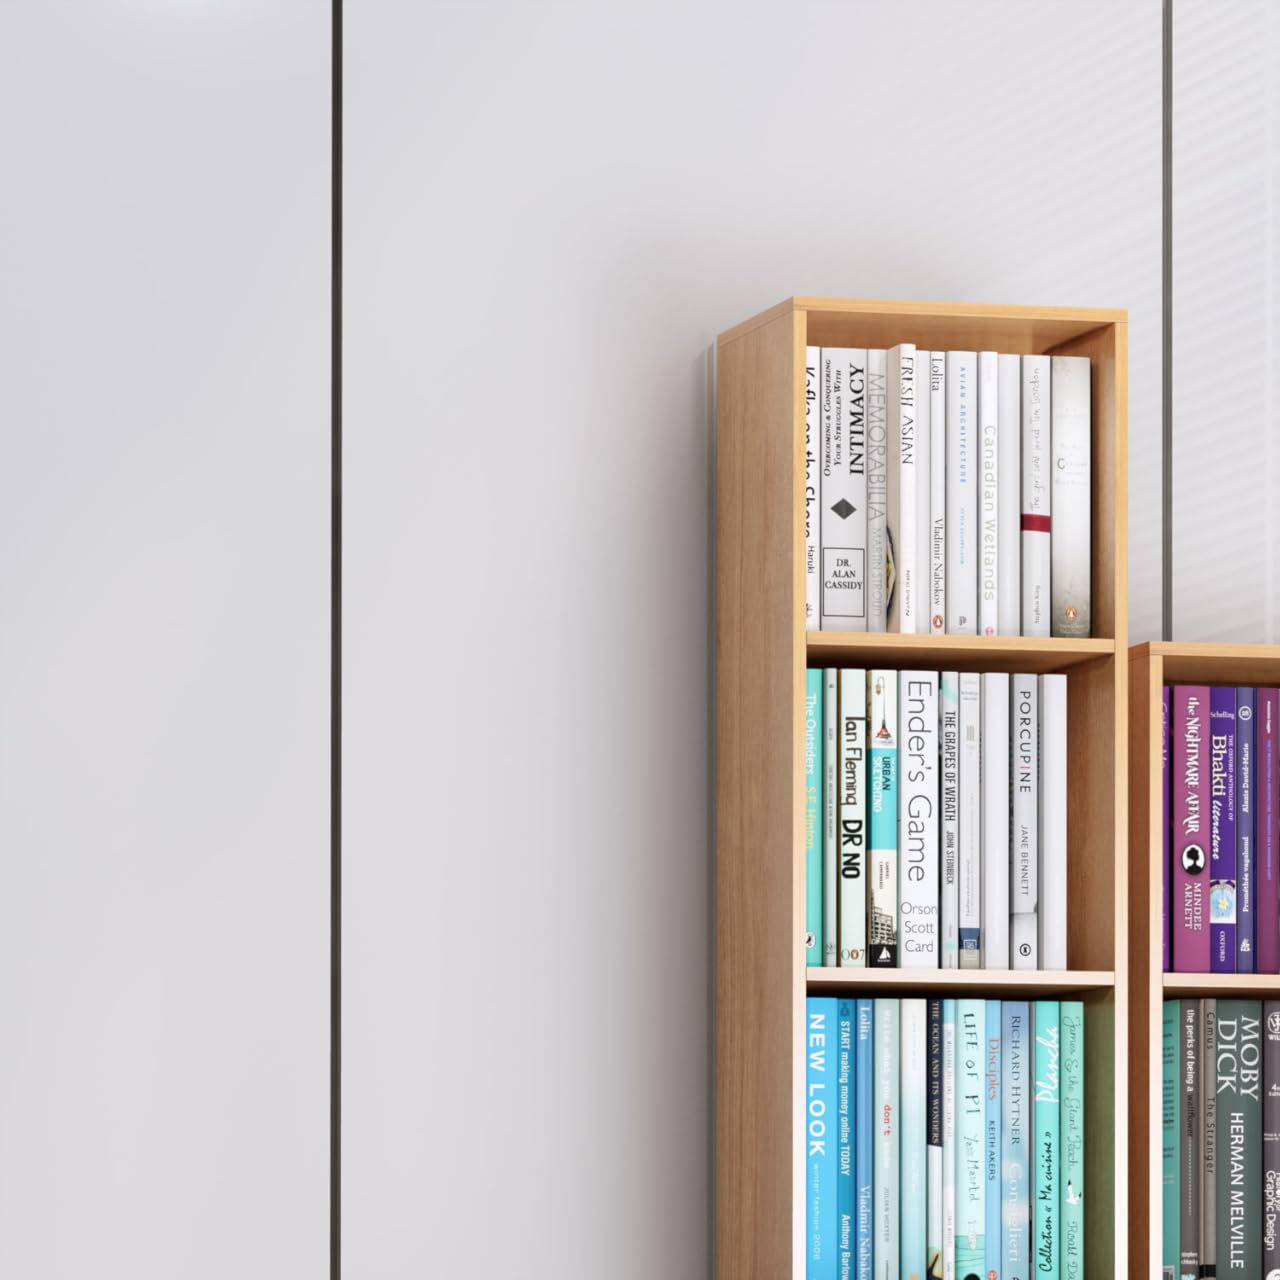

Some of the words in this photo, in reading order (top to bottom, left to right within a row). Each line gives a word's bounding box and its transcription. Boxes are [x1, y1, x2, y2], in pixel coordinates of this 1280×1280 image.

[901, 357, 913, 405] FRESH
[932, 358, 943, 391] Lolita
[850, 363, 864, 475] INTIMACY
[869, 373, 885, 521] MEMORABILIA
[901, 416, 913, 464] ASIAN
[984, 425, 996, 512] Canadian
[933, 518, 943, 559] Vladimir
[807, 546, 815, 573] Haruki
[836, 559, 850, 568] DR.
[984, 519, 996, 600] Wetlands
[825, 581, 862, 589] CASSIDY
[933, 564, 943, 605] Nabokov
[845, 716, 866, 742] Ian
[908, 680, 931, 782] Ender's
[945, 712, 955, 728] THE
[945, 732, 956, 768] GRAPES
[1020, 691, 1030, 792] PORCUPINE
[841, 747, 862, 805] Fleming
[882, 757, 890, 790] URBAN
[945, 772, 955, 784] OF
[1212, 735, 1227, 796] Bhakti
[944, 787, 955, 820] WRATH
[842, 819, 862, 846] DR
[908, 795, 931, 882] Game
[946, 831, 954, 847] JOHN
[1020, 825, 1029, 848] JANE
[1212, 800, 1222, 860] literature
[842, 854, 860, 878] NO
[946, 850, 954, 884] STEINBECK
[1020, 852, 1028, 896] BENNETT
[900, 902, 938, 914] Orson
[1184, 883, 1192, 929] ARNETT
[1194, 883, 1202, 930] MINDEE
[904, 921, 934, 933] Scott
[904, 940, 933, 952] Card
[810, 1013, 825, 1072] NEW
[841, 1021, 850, 1049] START
[860, 1007, 870, 1040] Lolita
[839, 1052, 850, 1082] making
[1011, 1016, 1020, 1080] RICHARD
[1217, 1019, 1236, 1094] DICK
[1240, 1016, 1258, 1101] MOBY
[986, 1039, 999, 1100] Disciples
[810, 1083, 825, 1156] LOOK
[839, 1086, 848, 1114] money
[1011, 1086, 1020, 1145] HYTNER
[841, 1117, 850, 1142] online
[1205, 1123, 1215, 1174] Stranger
[1230, 1113, 1243, 1185] HERMAN
[841, 1146, 850, 1175] TODAY
[1264, 1170, 1276, 1212] Graphic
[840, 1215, 850, 1249] Anthony
[1007, 1163, 1022, 1262] Consiglieri
[1231, 1191, 1243, 1268] MELVILLE
[1264, 1214, 1276, 1250] Design
[1066, 1221, 1076, 1256] Roald
